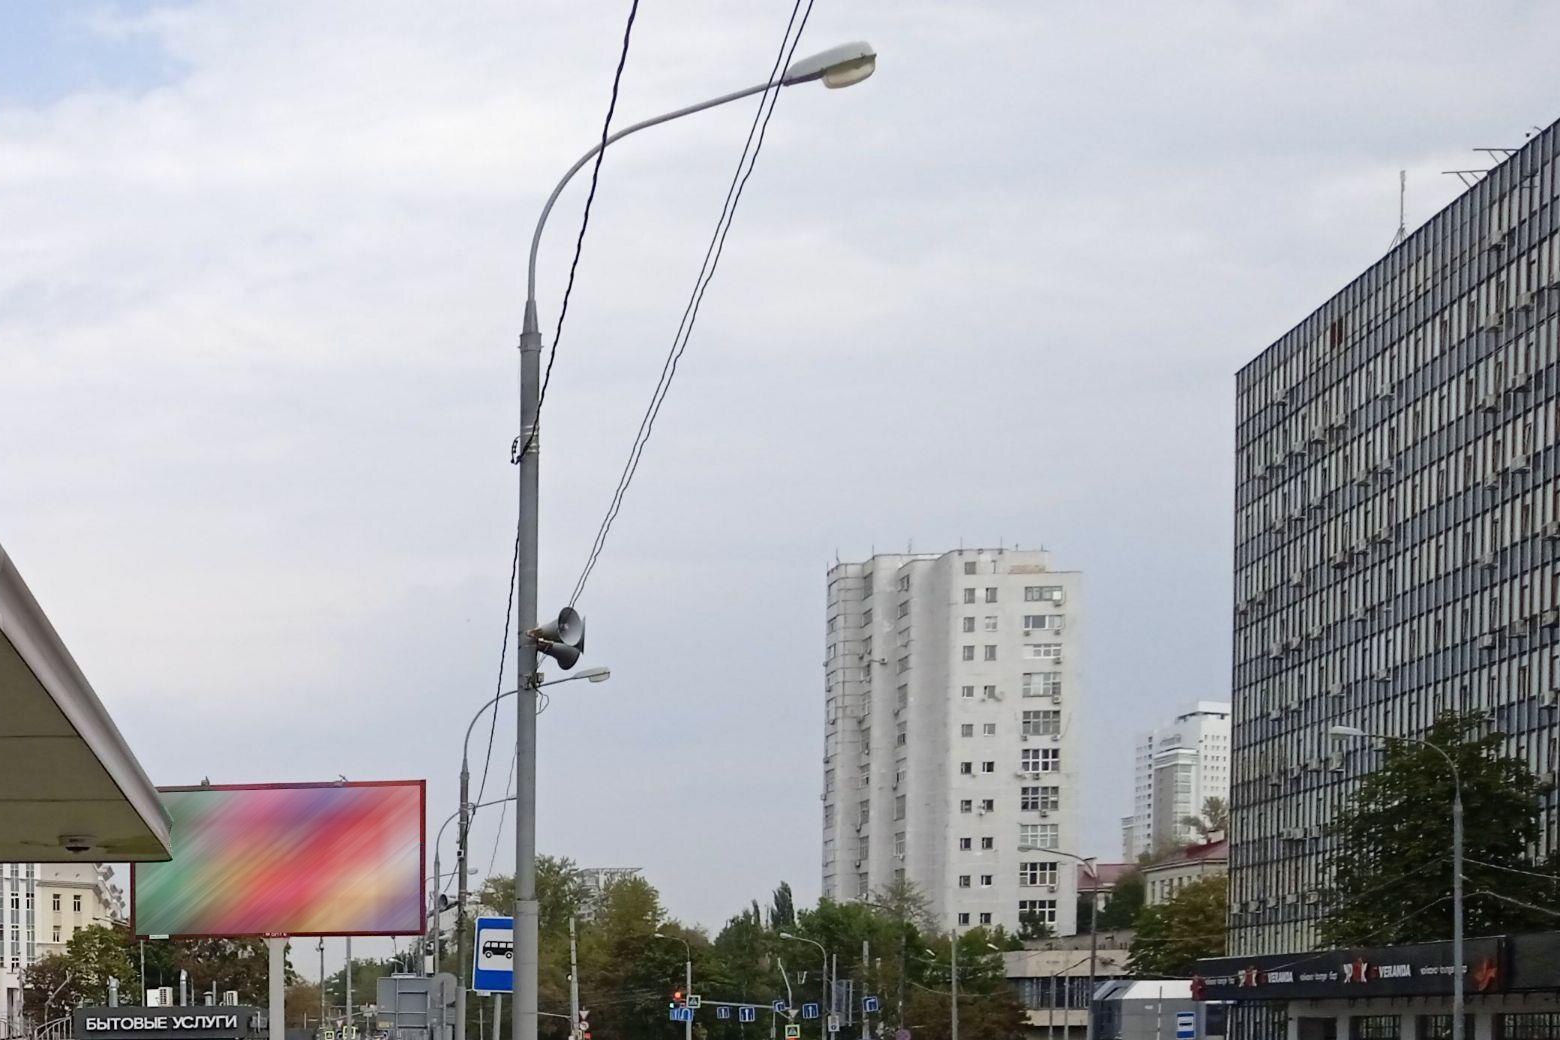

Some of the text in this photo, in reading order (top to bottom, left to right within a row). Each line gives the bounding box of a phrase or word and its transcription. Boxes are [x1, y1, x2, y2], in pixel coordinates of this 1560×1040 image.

[1378, 964, 1411, 979] VERANDA
[86, 1014, 238, 1031] БЫТОВЫЕ УСЛУГИ
